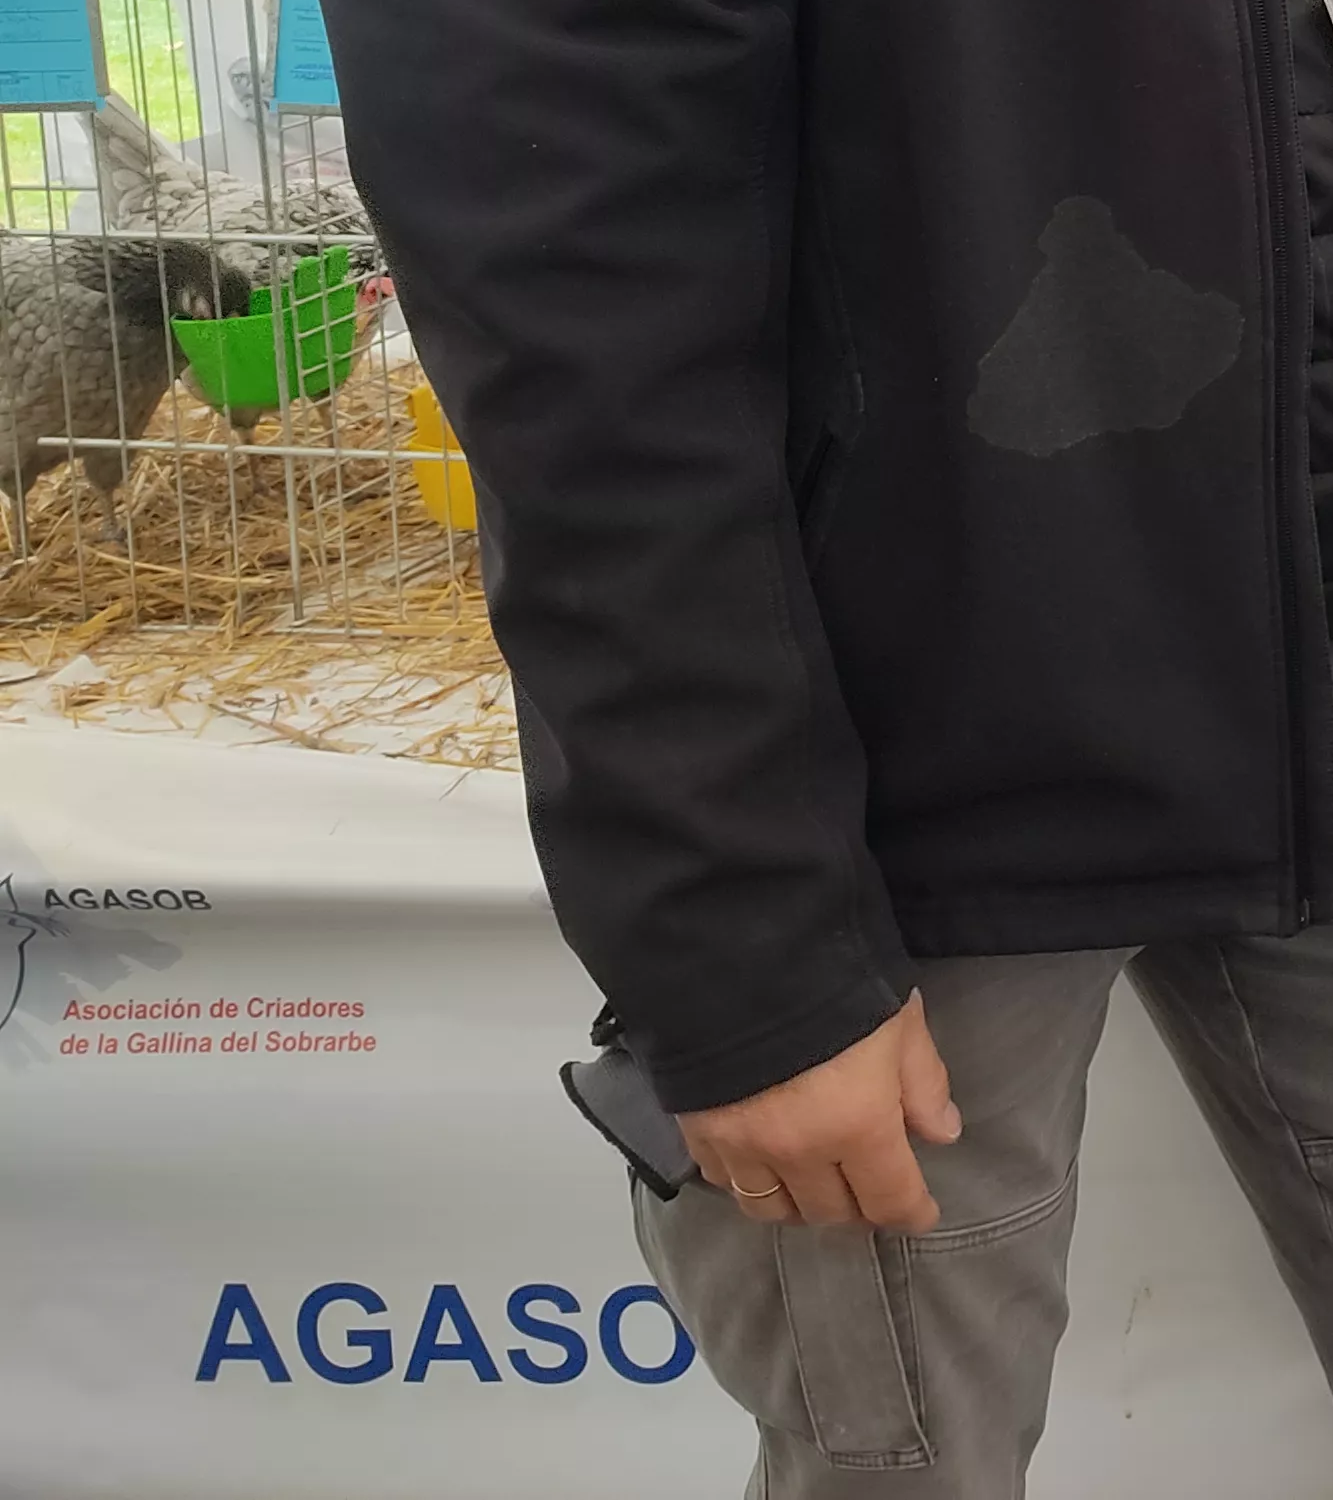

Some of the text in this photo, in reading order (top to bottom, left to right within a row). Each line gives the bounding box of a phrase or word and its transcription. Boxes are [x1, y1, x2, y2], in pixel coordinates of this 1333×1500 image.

[44, 888, 212, 911] AGASOB
[62, 996, 365, 1021] Asociación de Criadores
[59, 1030, 377, 1055] de la Gallina del Sobrarbe
